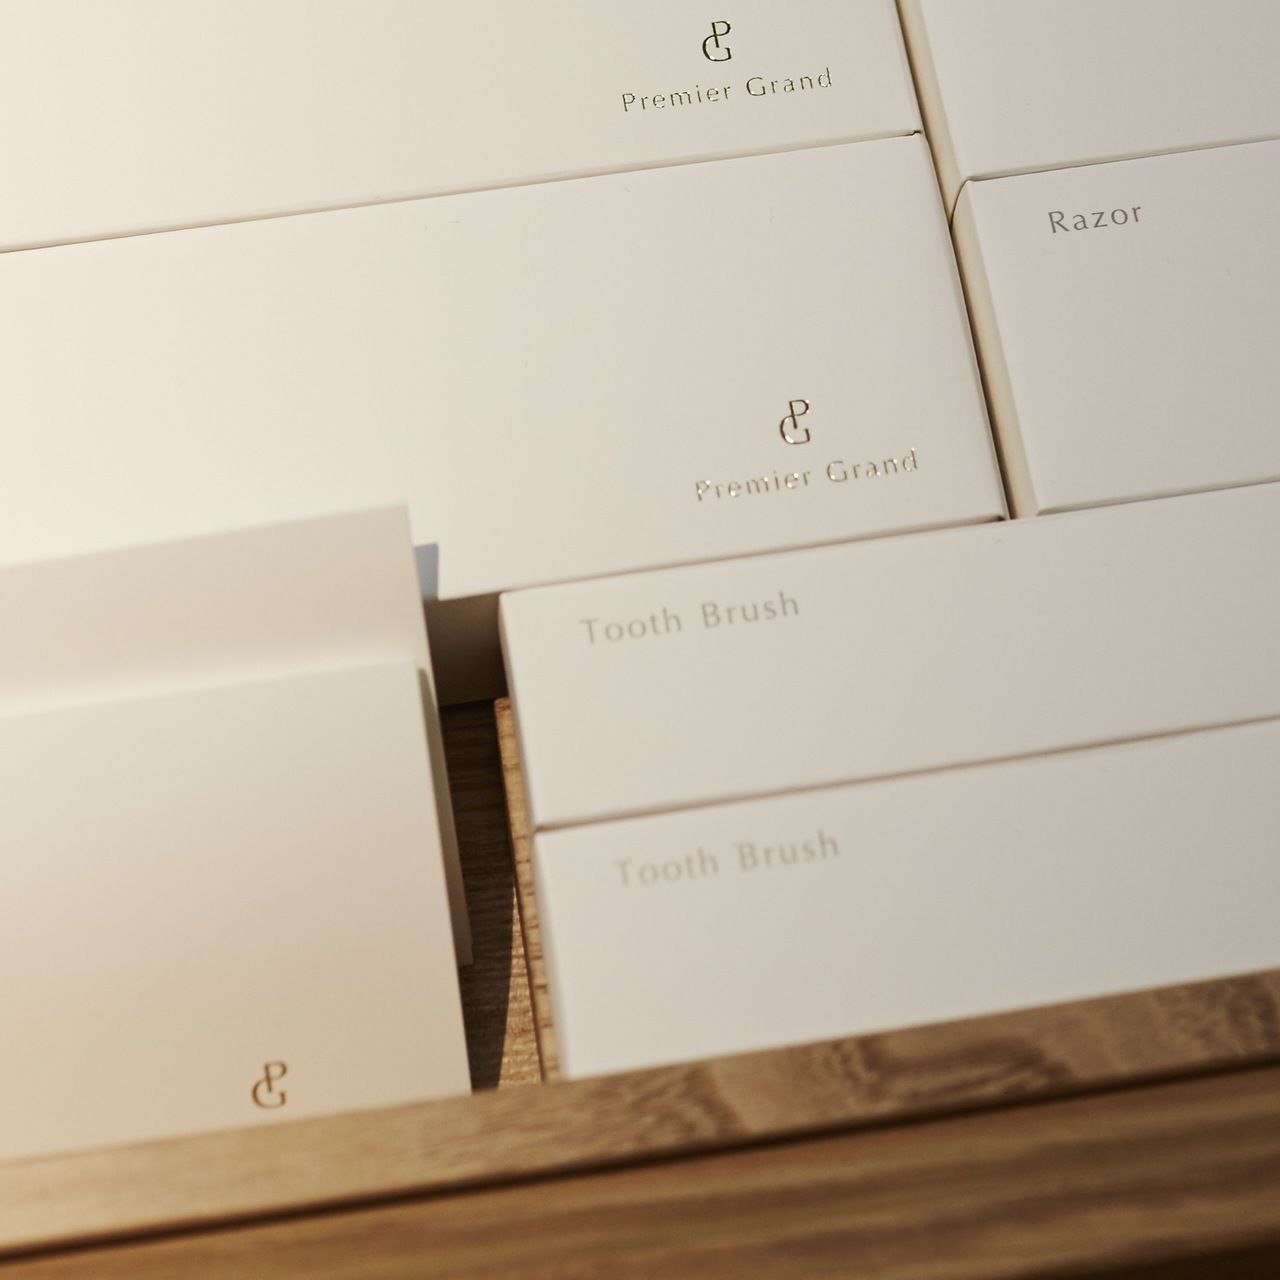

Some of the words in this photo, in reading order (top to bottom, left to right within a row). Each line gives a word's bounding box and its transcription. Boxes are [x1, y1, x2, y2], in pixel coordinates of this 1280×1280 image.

[621, 80, 733, 113] Premier
[745, 67, 834, 98] Grand
[1048, 205, 1143, 235] Razor
[694, 467, 813, 503] Premier
[825, 447, 920, 483] Grand
[579, 606, 683, 646] Tooth
[700, 589, 802, 630] Brush
[612, 846, 721, 890] Tooth
[732, 829, 841, 873] Brush
